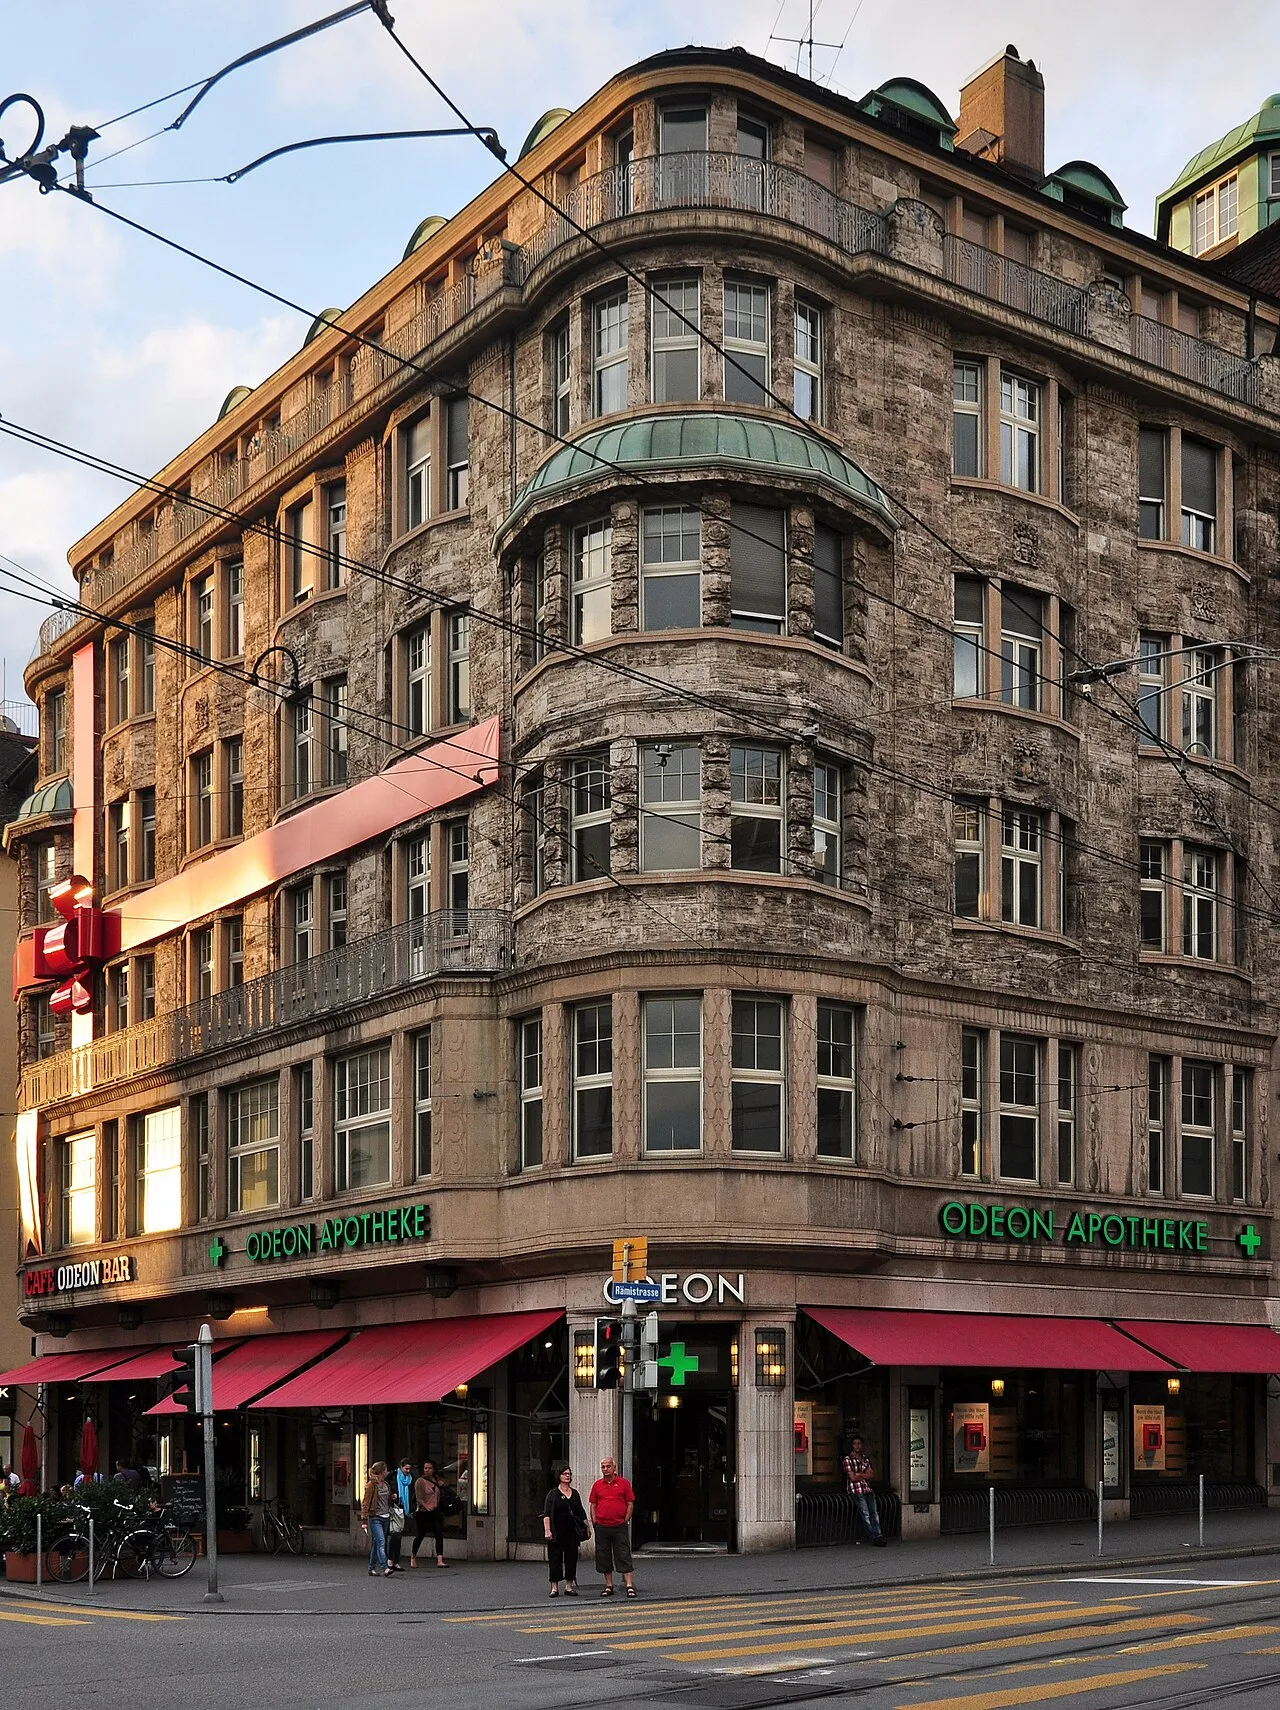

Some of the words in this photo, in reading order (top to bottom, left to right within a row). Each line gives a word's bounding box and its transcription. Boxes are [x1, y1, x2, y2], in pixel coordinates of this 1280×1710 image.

[246, 1223, 311, 1261] ODEON
[320, 1204, 425, 1249] APOTHEKE
[943, 1202, 1053, 1239] ODEON
[1067, 1211, 1209, 1251] APOTHEKE
[25, 1267, 55, 1296] CAFE
[57, 1260, 100, 1291] ODEON
[101, 1255, 131, 1284] BAR
[615, 1285, 659, 1297] Rämistrasse
